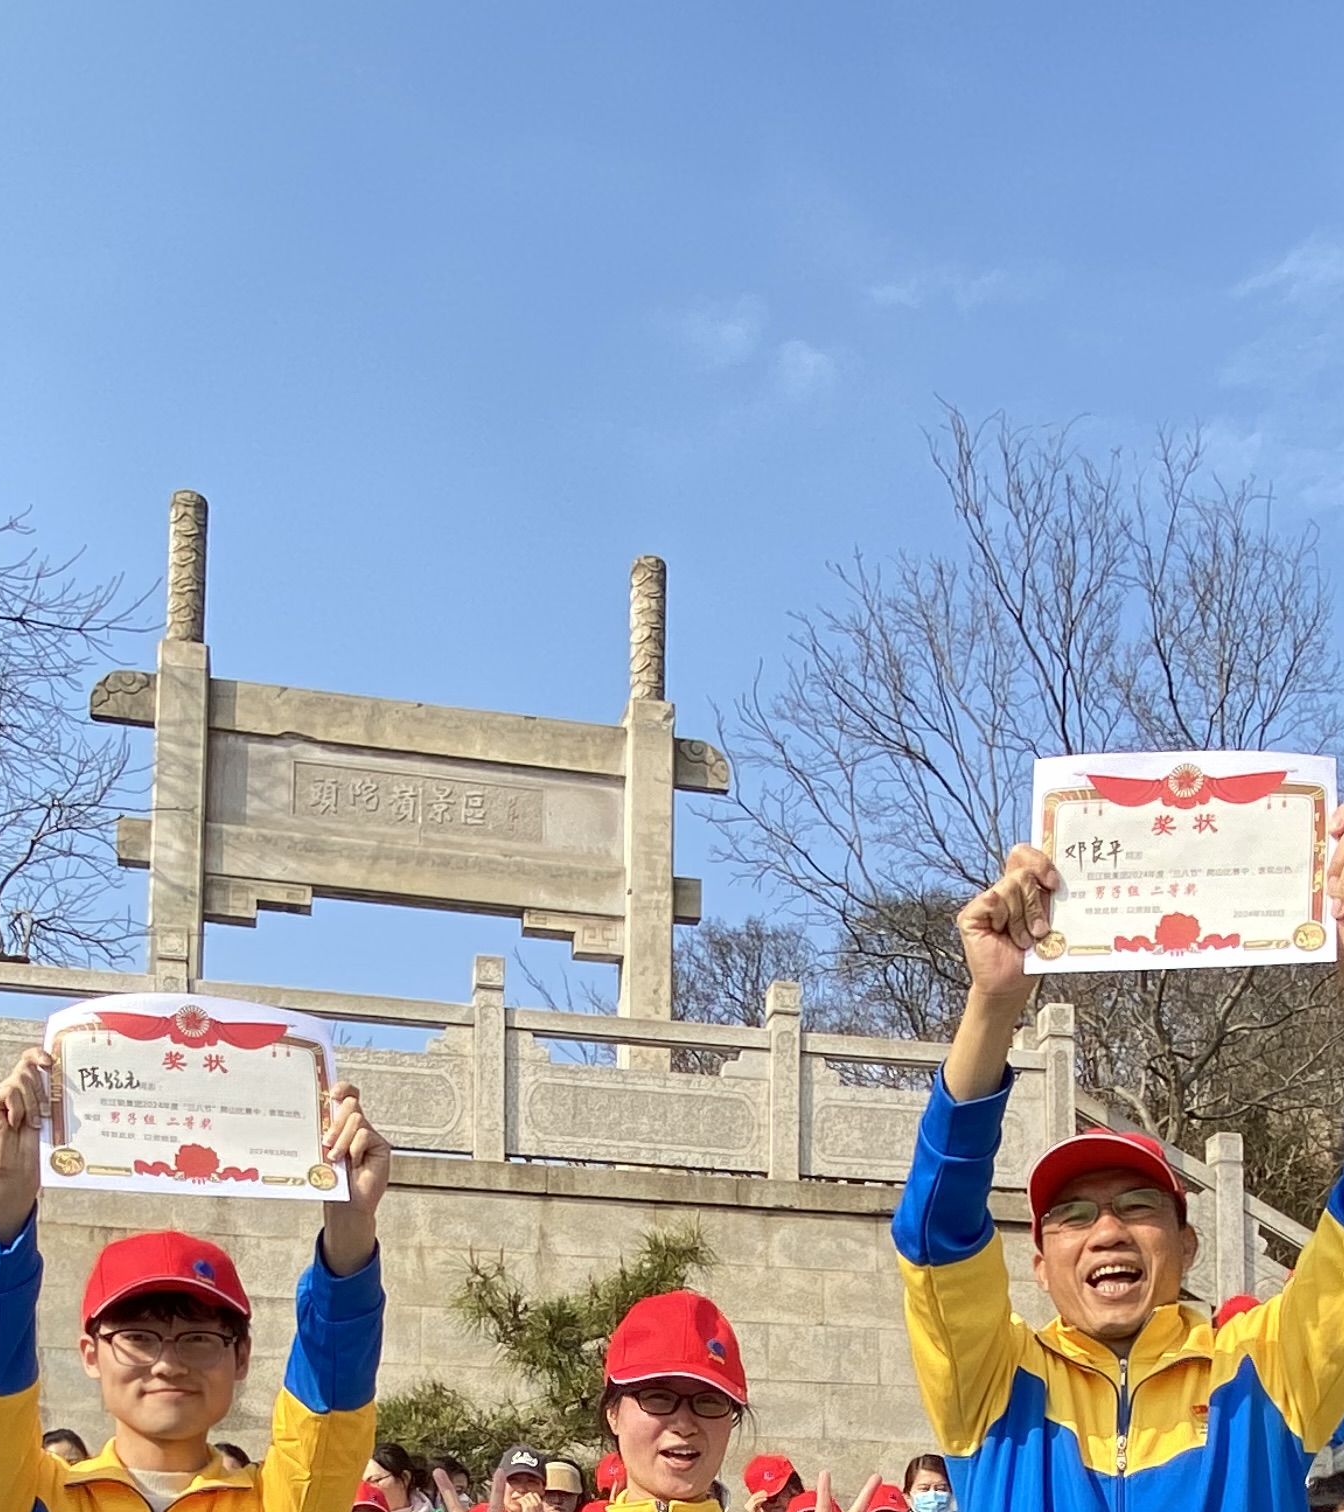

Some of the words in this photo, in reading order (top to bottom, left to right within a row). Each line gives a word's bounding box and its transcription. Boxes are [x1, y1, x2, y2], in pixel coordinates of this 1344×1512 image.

[1151, 813, 1218, 836] 奖状
[1064, 837, 1124, 872] 邓良平
[162, 1051, 229, 1074] 奖状
